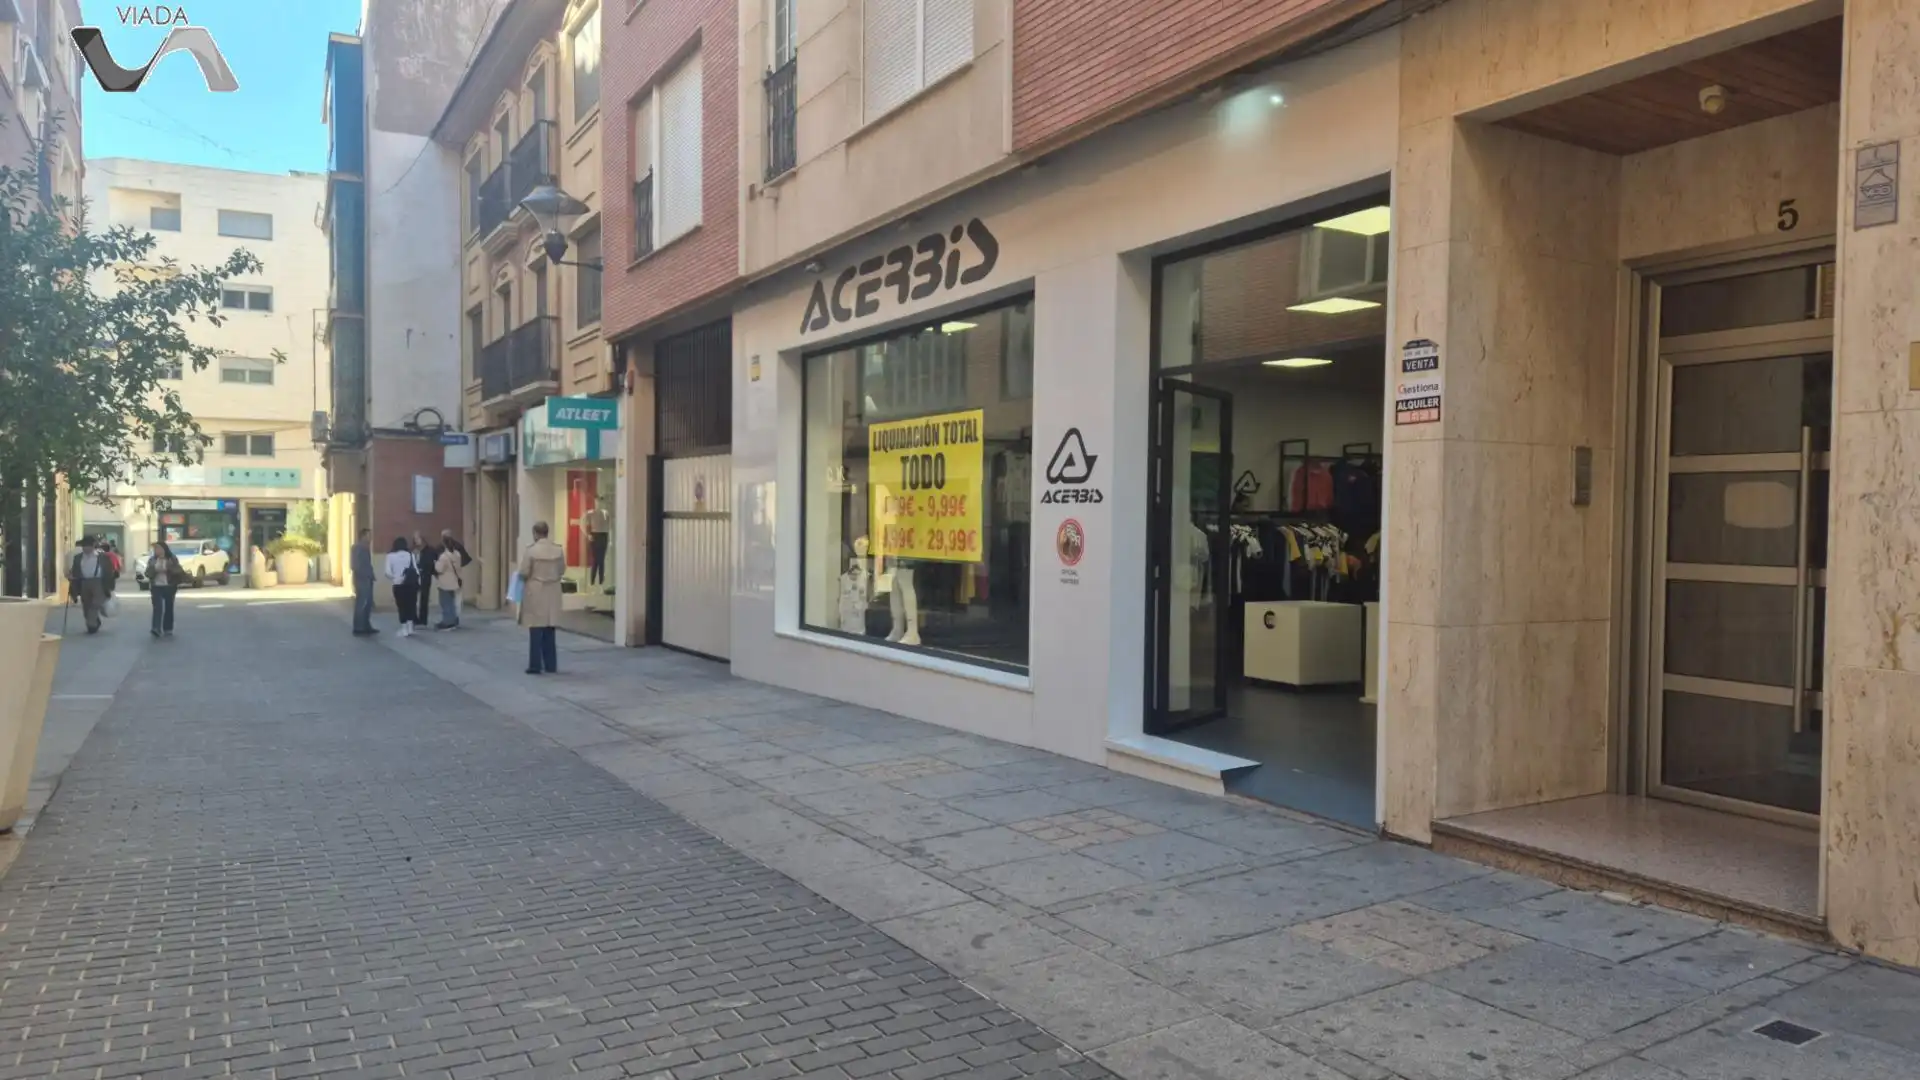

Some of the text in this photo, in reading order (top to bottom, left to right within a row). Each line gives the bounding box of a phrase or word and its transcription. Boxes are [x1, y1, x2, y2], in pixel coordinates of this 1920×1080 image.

[1777, 198, 1799, 231] 5
[1406, 359, 1435, 370] VENTA
[556, 407, 611, 422] ATLEET
[1397, 398, 1440, 411] ALQUILER
[873, 418, 979, 453] LIQUIDACIÓN TOTAL
[900, 453, 945, 490] TODO
[927, 494, 967, 521] 9,99€
[927, 527, 977, 555] 29,99€
